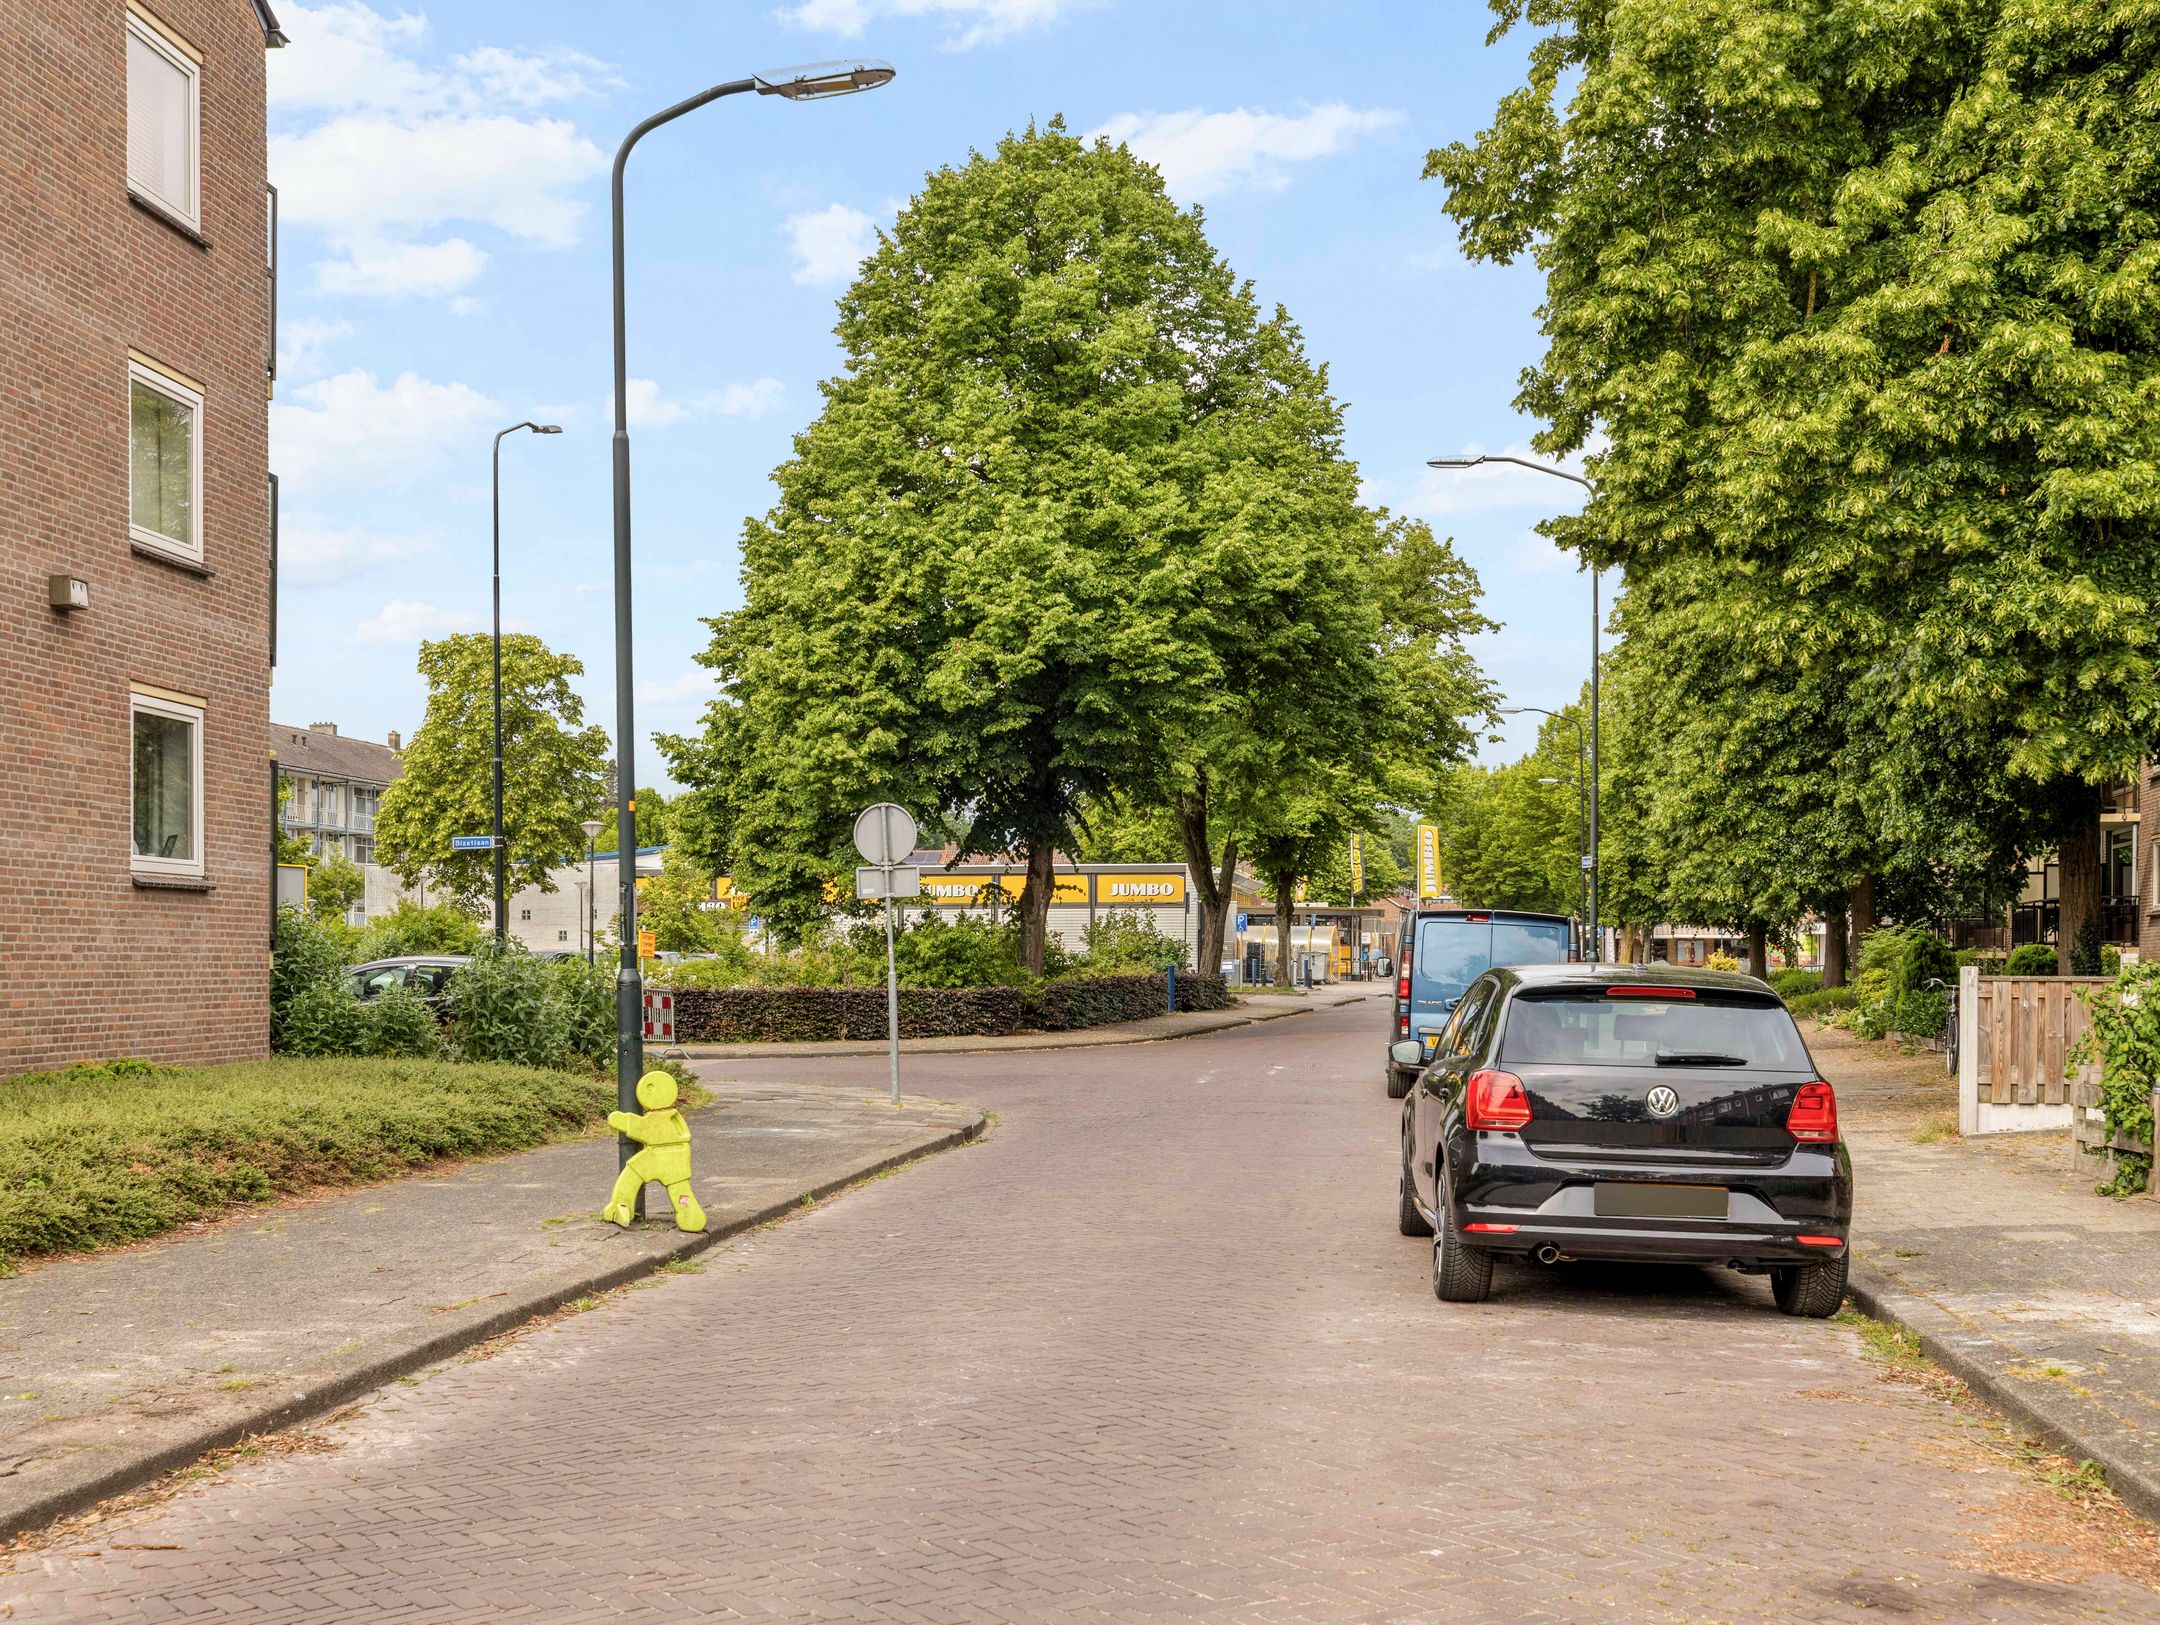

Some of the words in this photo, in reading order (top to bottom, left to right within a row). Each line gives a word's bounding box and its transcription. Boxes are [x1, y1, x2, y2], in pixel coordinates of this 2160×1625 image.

[455, 839, 490, 847] Bizetlaan
[1423, 830, 1438, 894] JUMBO
[924, 884, 978, 897] UMBO
[1110, 883, 1174, 896] JUMBO
